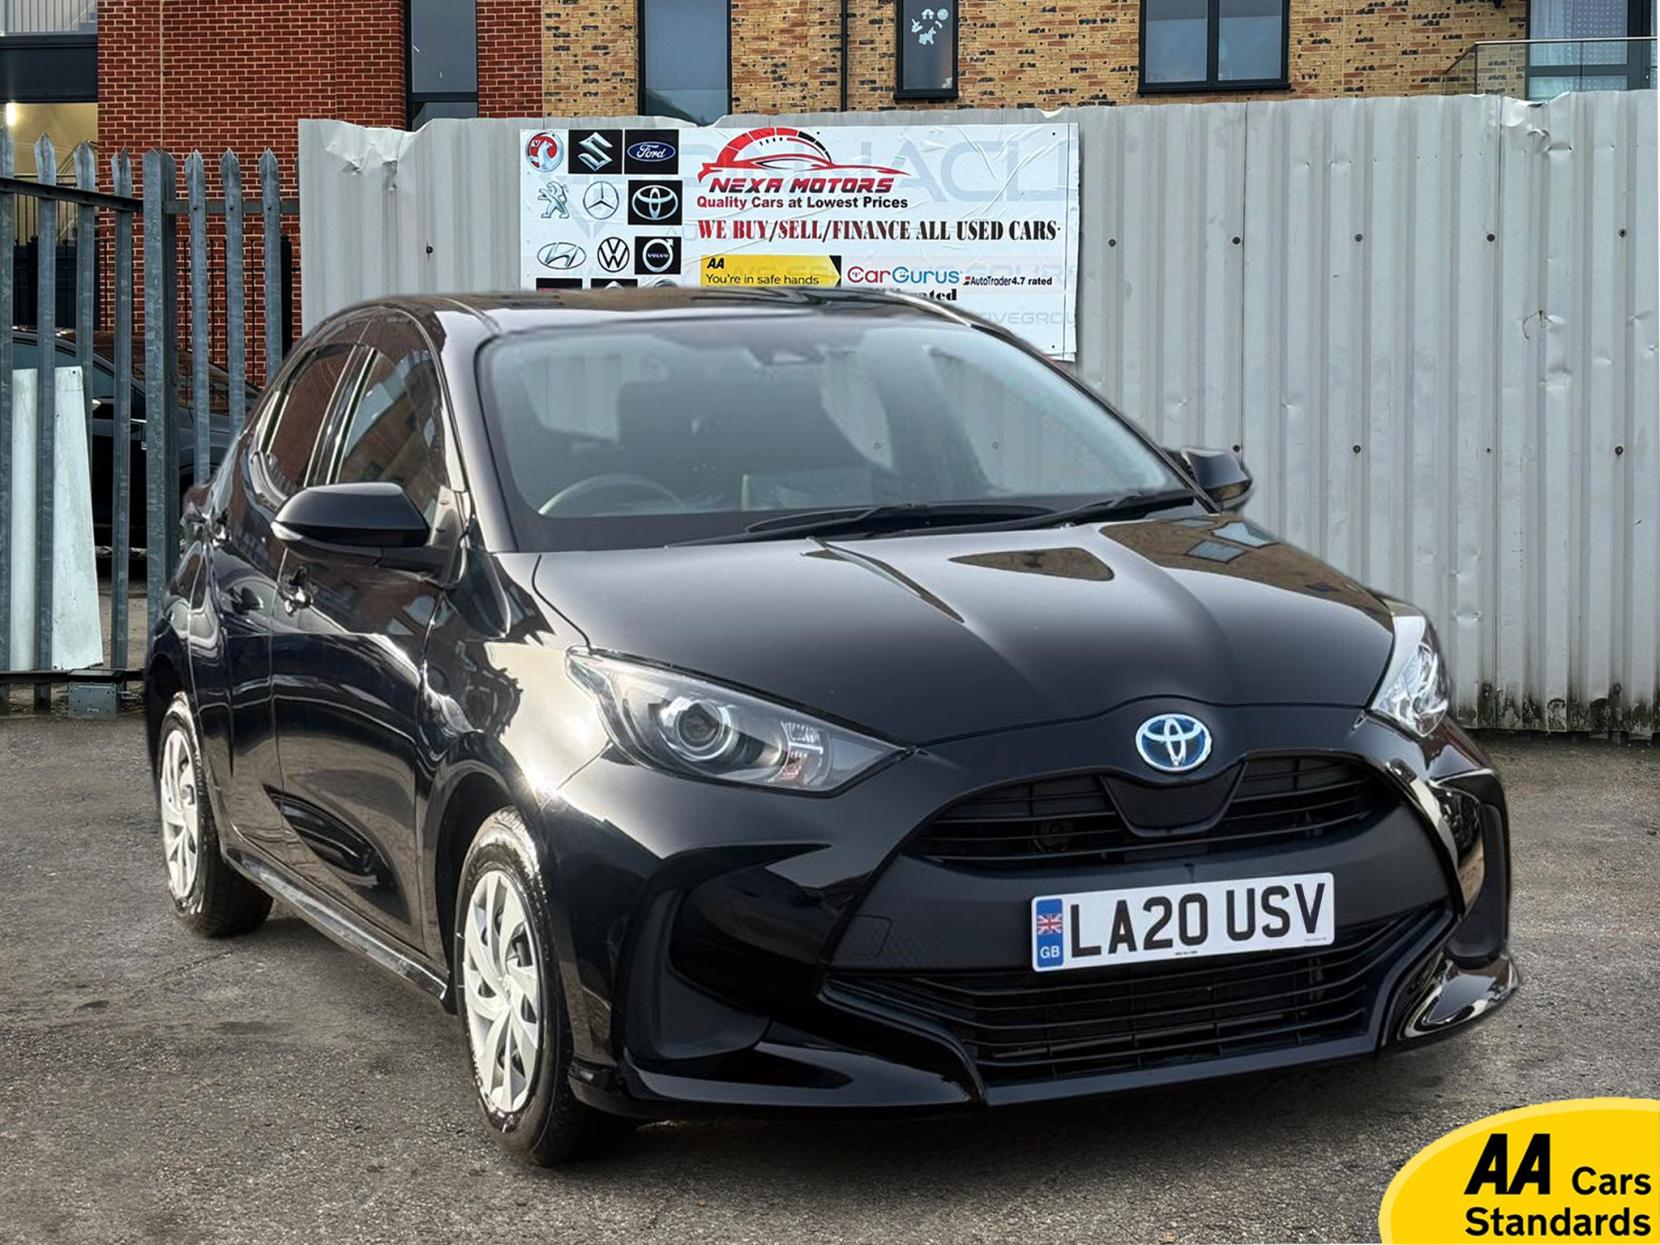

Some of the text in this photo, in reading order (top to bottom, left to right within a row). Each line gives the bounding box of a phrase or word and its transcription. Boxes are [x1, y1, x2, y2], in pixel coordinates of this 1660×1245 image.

[635, 144, 666, 158] Ford
[709, 177, 895, 193] NEXA MOTORS
[697, 195, 908, 210] Quality Cars at Lowest Prices
[697, 220, 726, 240] WE
[916, 220, 950, 240] ALL
[956, 220, 1003, 240] USED
[1008, 220, 1057, 240] CARS
[706, 257, 725, 269] AA
[706, 273, 819, 286] You're in safe hands
[847, 266, 960, 284] CarGurus
[1028, 277, 1052, 285] rated
[1070, 882, 1326, 958] LA20 USV
[1039, 946, 1060, 959] GB
